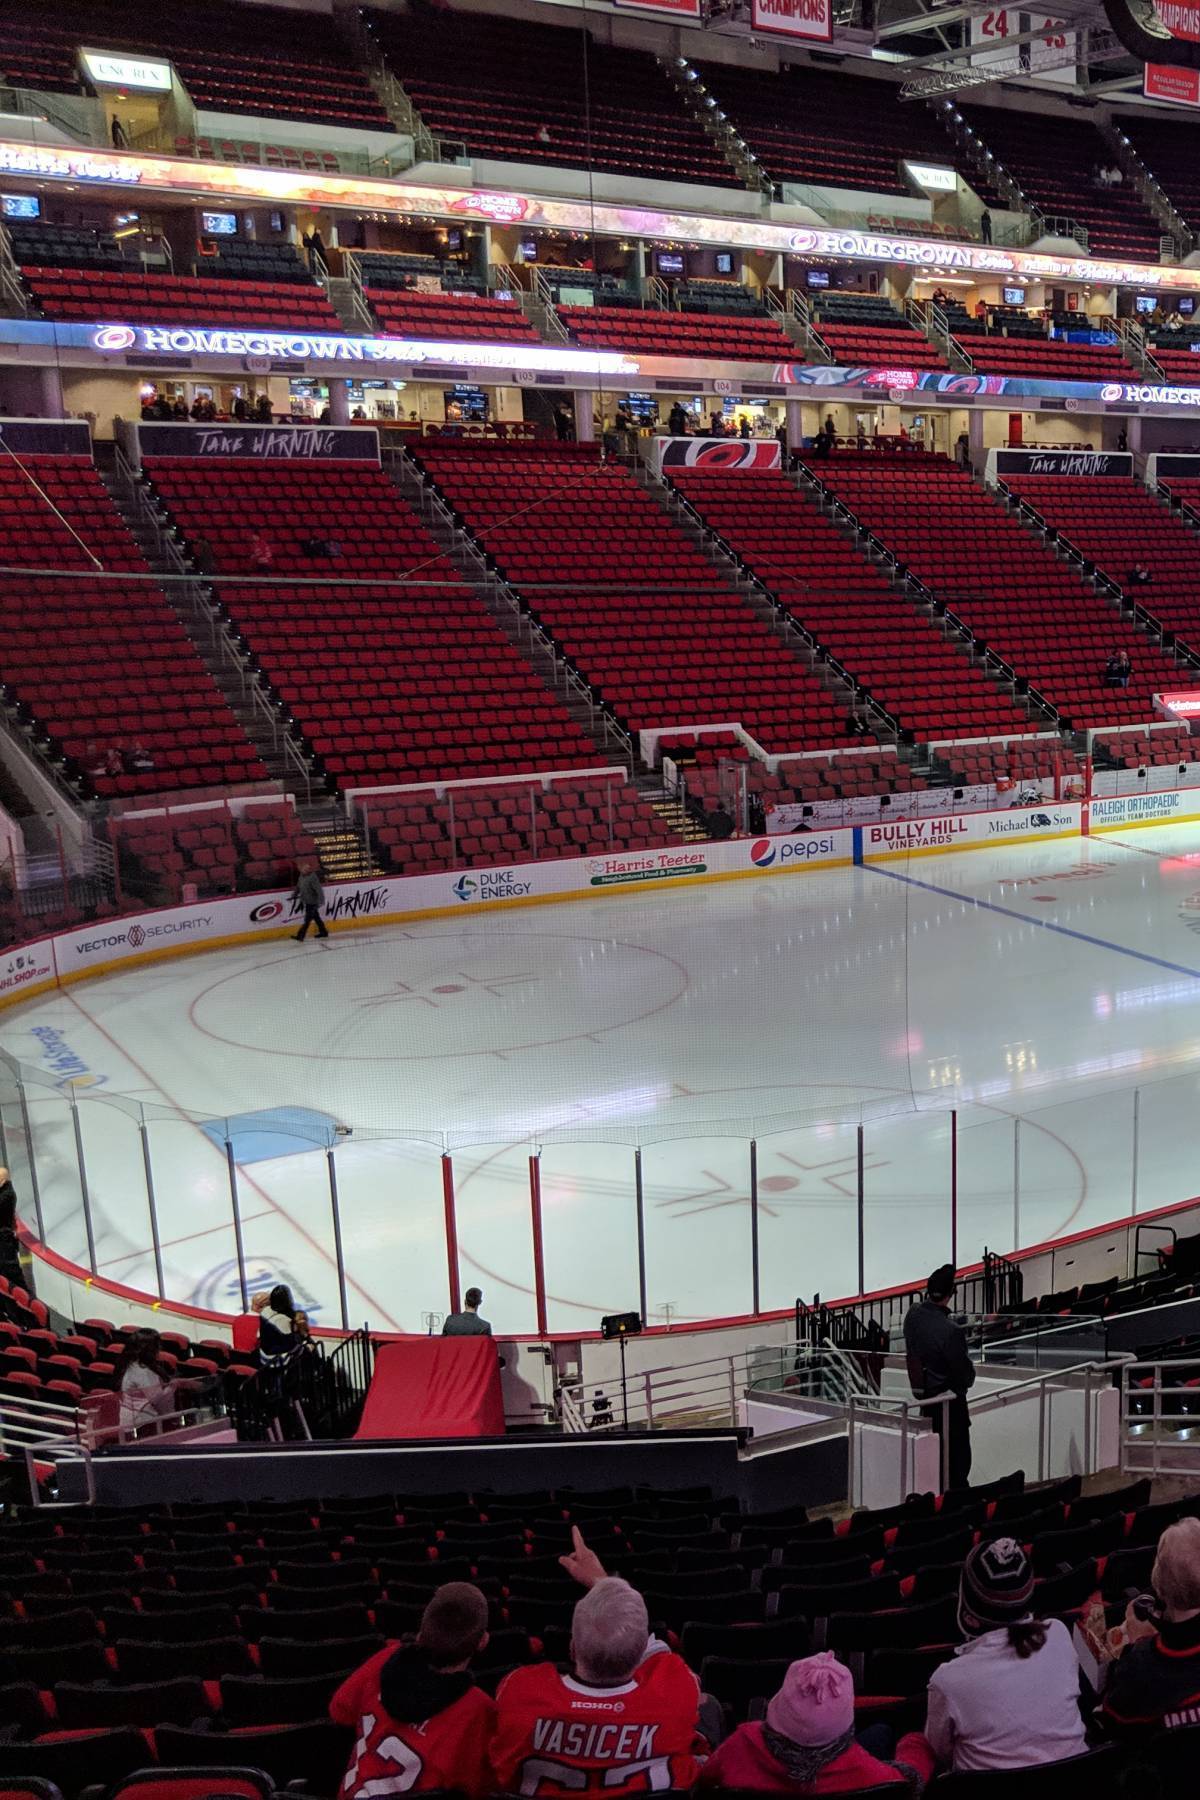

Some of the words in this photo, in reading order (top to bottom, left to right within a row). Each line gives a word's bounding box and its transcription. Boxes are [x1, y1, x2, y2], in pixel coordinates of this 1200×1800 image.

[981, 10, 1008, 38] 24
[821, 233, 973, 267] HOMEGROWN
[144, 326, 366, 360] HOMEGROWN
[885, 378, 914, 386] GROWN
[886, 370, 913, 379] HOME
[195, 430, 244, 454] TAKE
[252, 429, 336, 460] WARNING
[1029, 456, 1057, 473] TAKE
[1060, 453, 1110, 478] WARNING
[1092, 798, 1126, 817] RALEIGH
[1126, 793, 1180, 812] ORTHOPAEDIC
[1100, 814, 1126, 824] OFFICIAL
[1127, 811, 1144, 821] TEAM
[1144, 808, 1172, 818] DOCTORS
[870, 822, 926, 843] BULLY
[930, 818, 969, 837] HILL
[988, 817, 1029, 834] Michael
[1052, 814, 1073, 827] Son
[780, 835, 835, 861] pepsi
[887, 834, 953, 851] VINEYARDS
[604, 858, 655, 874] Harris
[657, 852, 706, 868] Teeter
[480, 870, 514, 886] DUKE
[480, 881, 532, 900] ENERGY
[325, 885, 392, 921] WARNING
[76, 934, 127, 954] VECTOR
[146, 916, 210, 938] SECURITY
[532, 1717, 661, 1760] VASICEK
